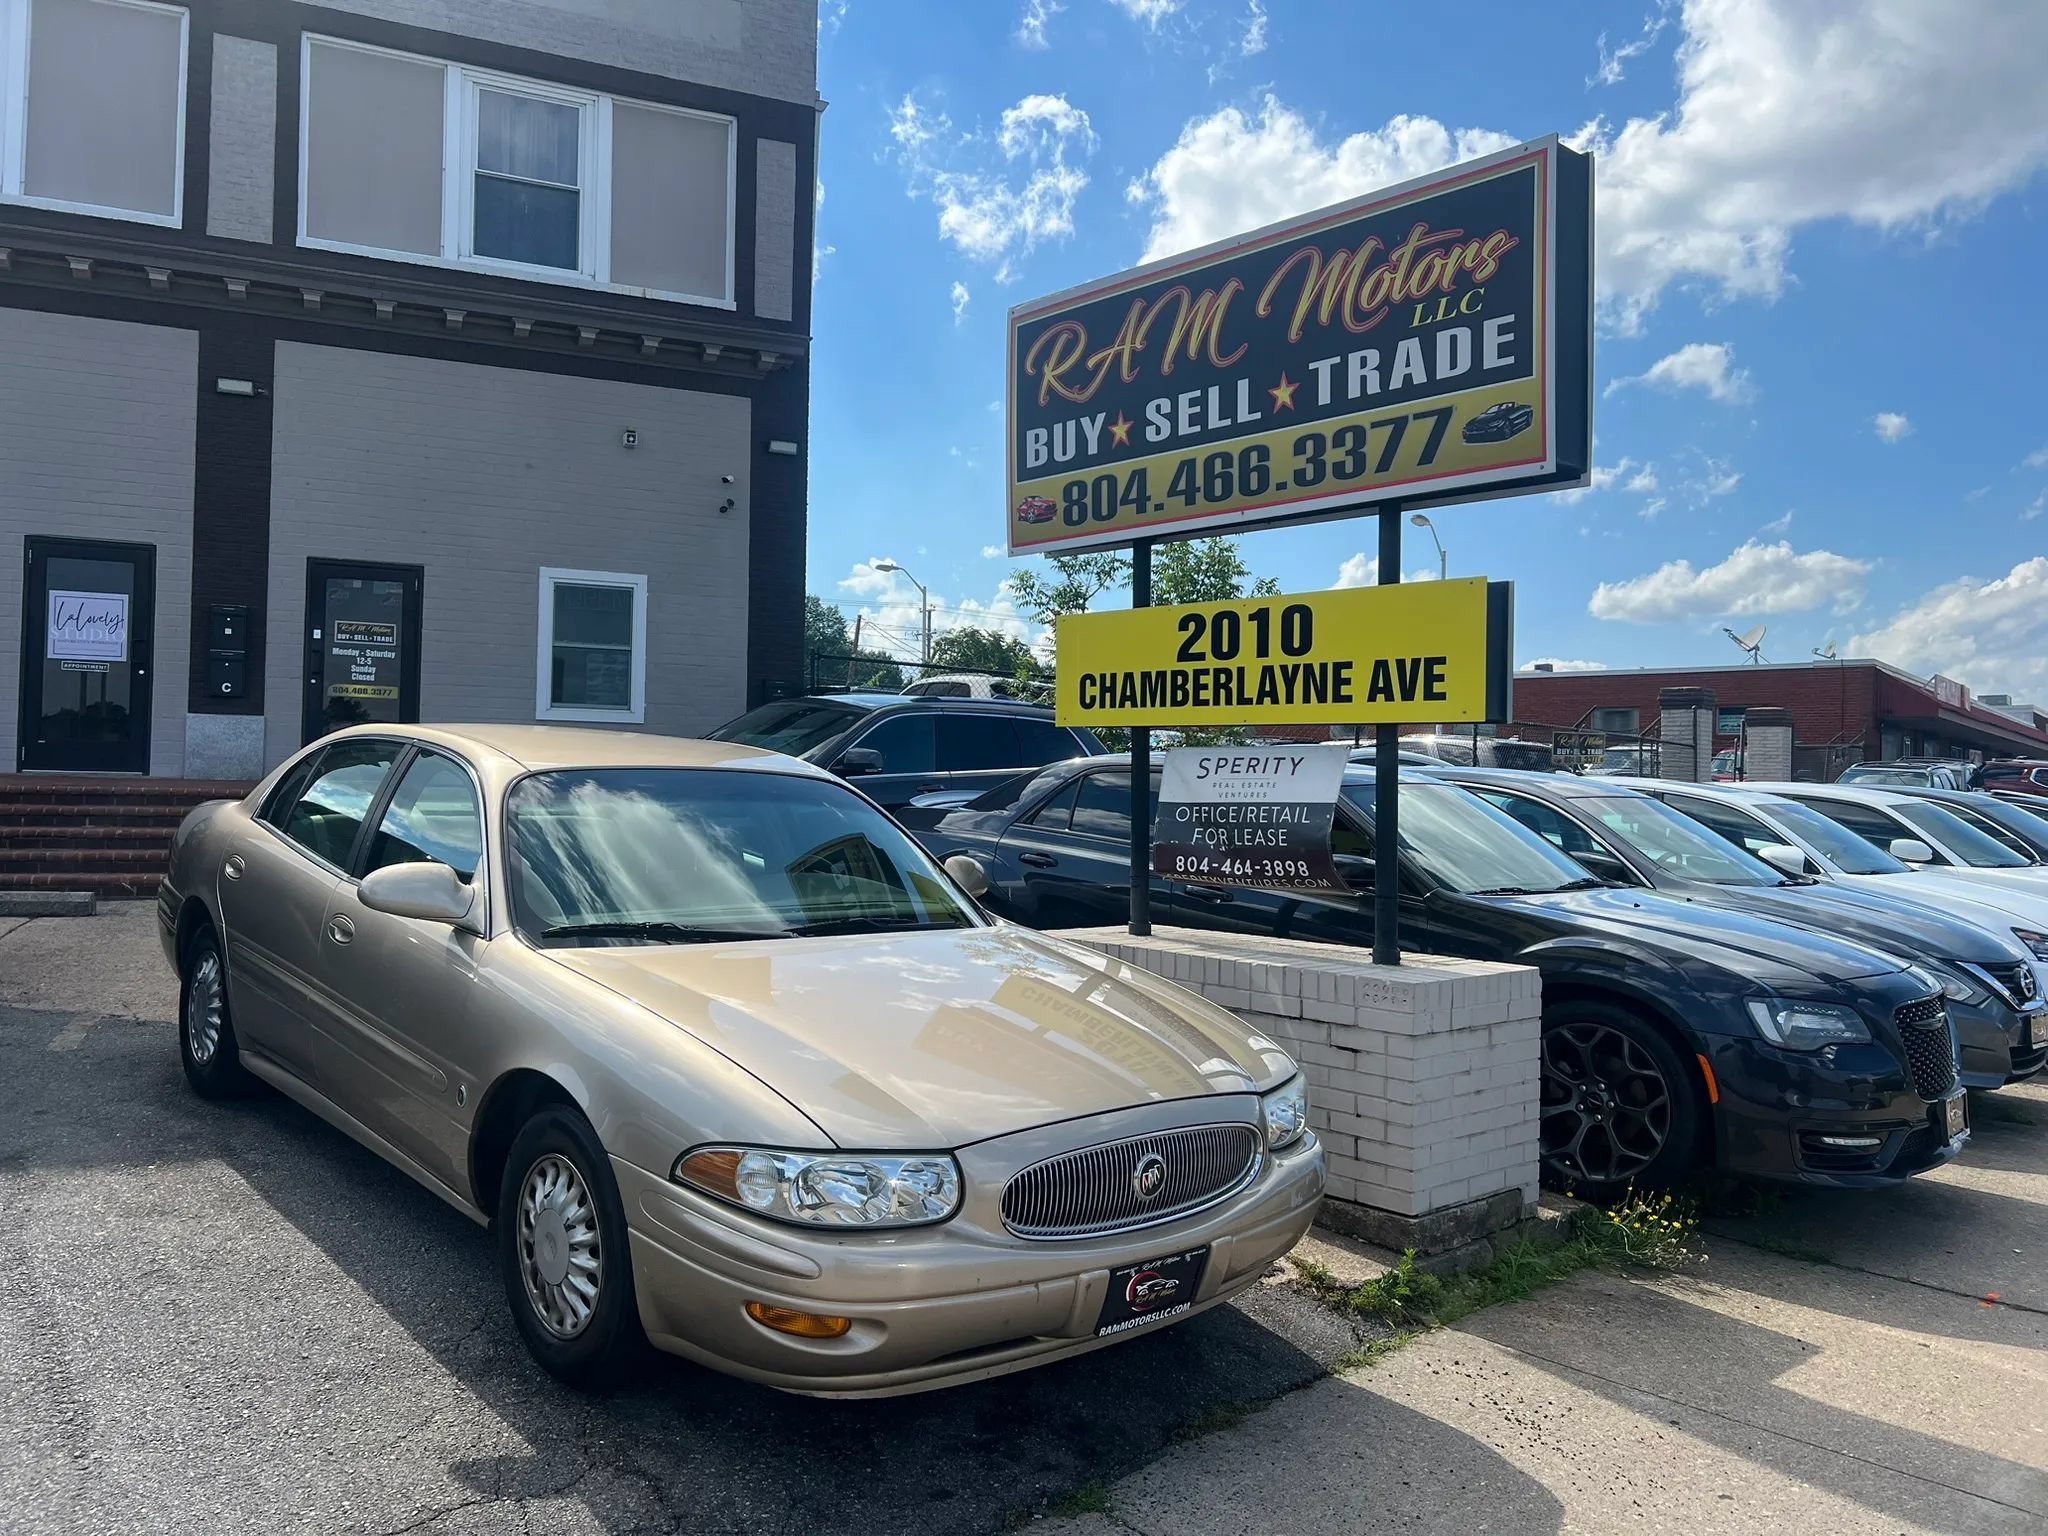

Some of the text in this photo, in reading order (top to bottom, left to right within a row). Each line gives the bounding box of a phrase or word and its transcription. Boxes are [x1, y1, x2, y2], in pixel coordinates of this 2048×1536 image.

[1025, 222, 1519, 408] RAM Motors
[1411, 287, 1486, 330] LLC
[1026, 313, 1516, 469] BUY SELL TRADE
[1062, 405, 1455, 528] 804.466.3377
[373, 635, 393, 643] TRADE
[1176, 604, 1313, 663] 2010
[332, 647, 360, 657] Monday
[366, 649, 395, 659] Saturday
[356, 657, 372, 665] 12-5
[63, 663, 107, 671] APPOINTMENT
[351, 665, 376, 674] Sunday
[352, 673, 375, 681] Closed
[1079, 656, 1447, 710] CHAMBERLAYNE AVE
[221, 682, 232, 692] C
[1197, 757, 1305, 779] SPERITY
[1218, 791, 1268, 799] VENTURES
[1175, 806, 1311, 824] OFFICE/RETAIL
[1191, 827, 1288, 846] FOR LEASE
[1175, 855, 1310, 877] 804-464-3898
